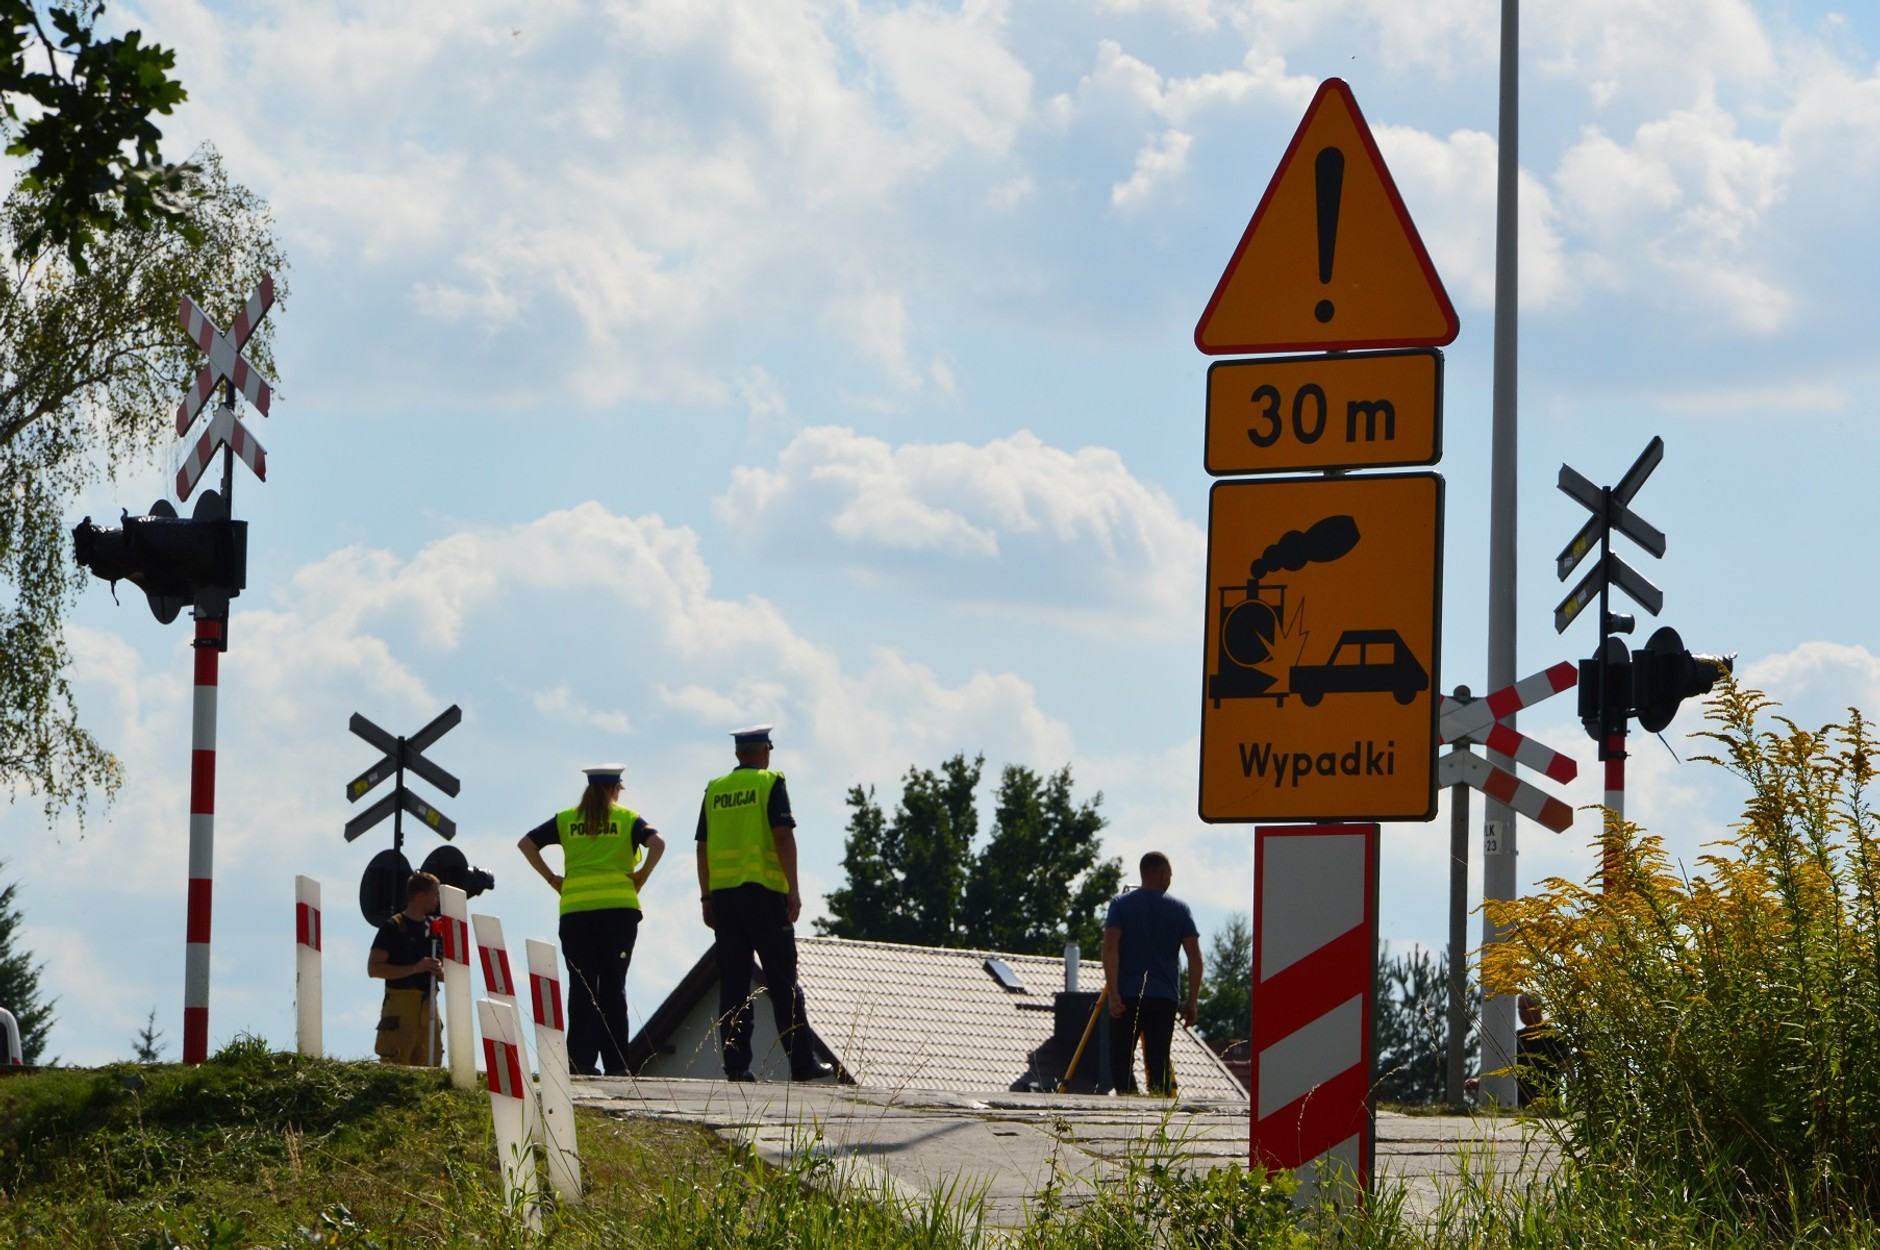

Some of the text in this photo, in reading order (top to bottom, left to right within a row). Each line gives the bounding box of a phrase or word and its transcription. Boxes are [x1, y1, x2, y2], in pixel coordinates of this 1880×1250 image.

[1247, 383, 1396, 448] 30 m
[1238, 740, 1395, 788] Wypadki
[713, 789, 756, 809] POLICJA
[570, 822, 618, 836] POCJA
